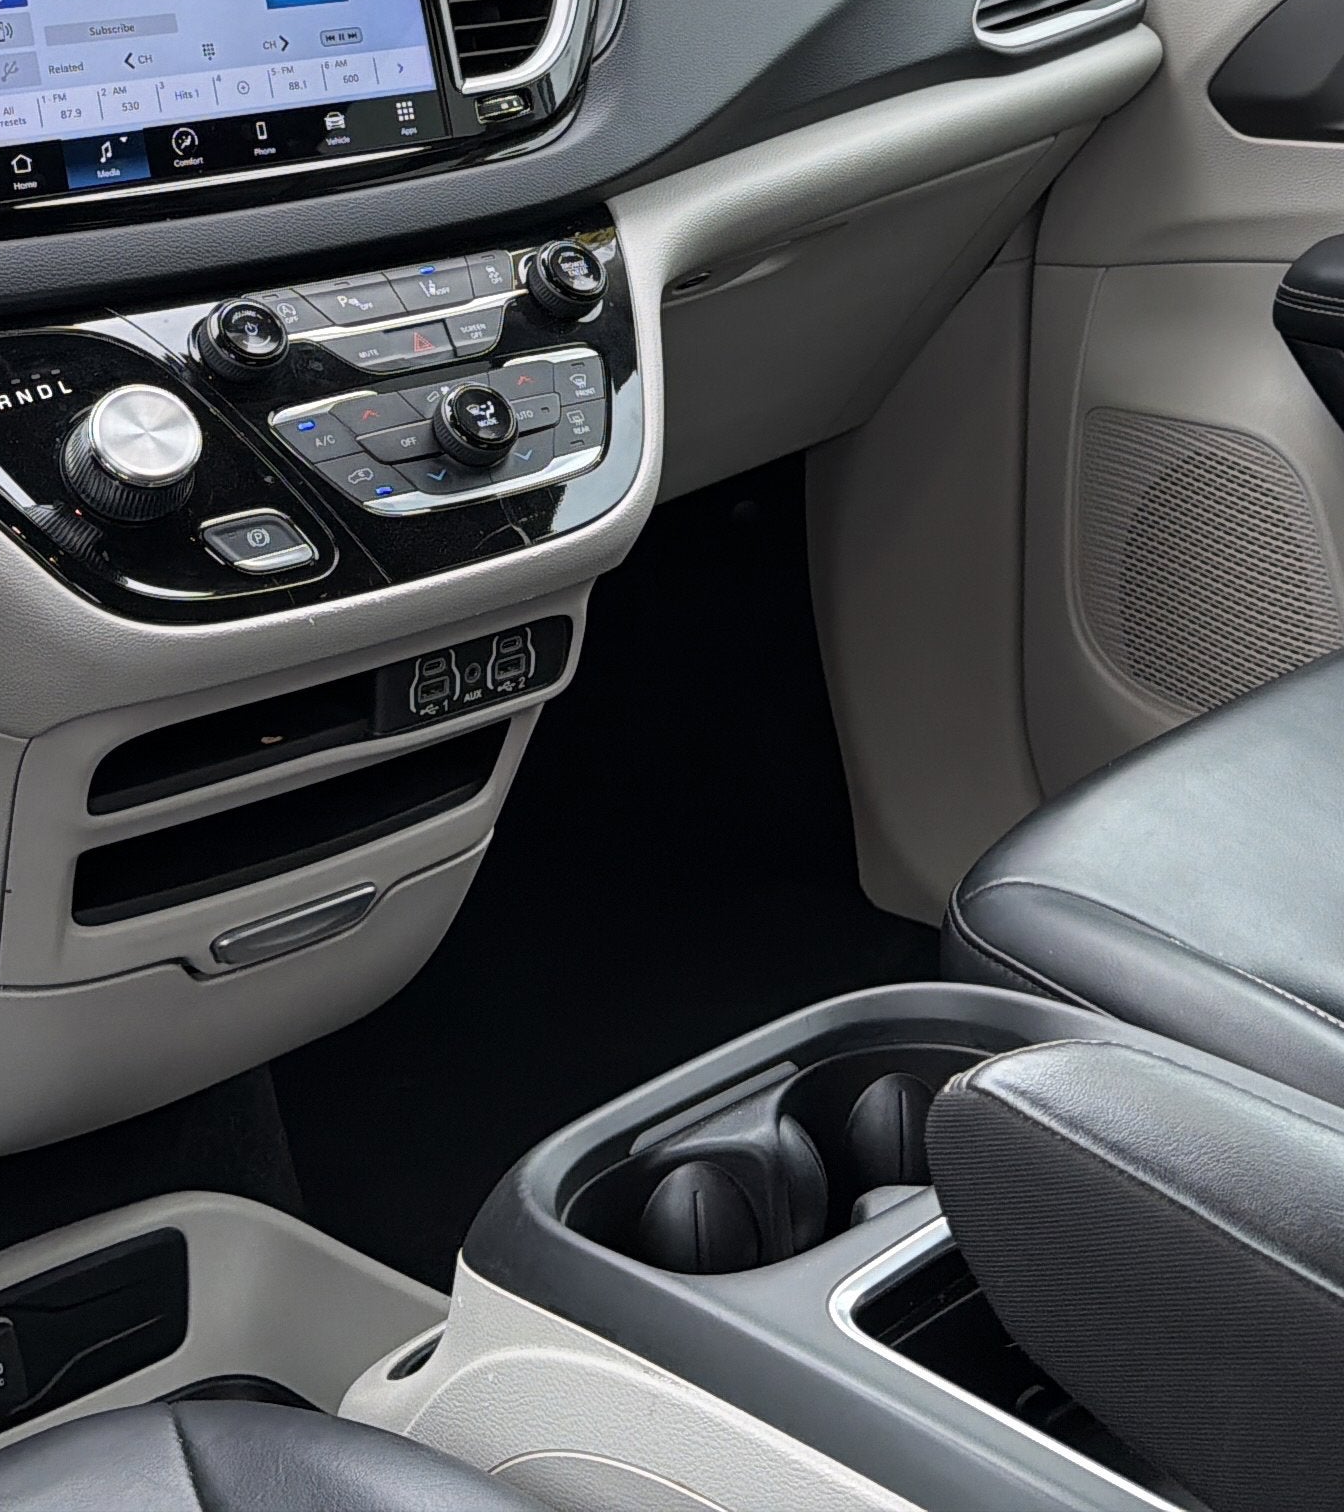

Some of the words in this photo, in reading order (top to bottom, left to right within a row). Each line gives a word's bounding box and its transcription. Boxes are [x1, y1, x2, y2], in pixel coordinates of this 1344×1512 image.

[89, 23, 135, 36] Subscribe
[262, 39, 277, 50] CH
[137, 54, 153, 65] CH
[48, 62, 84, 75] Related
[343, 74, 359, 84] 600
[288, 80, 307, 91] 88.1
[174, 90, 193, 101] Hits
[3, 106, 15, 116] All
[121, 101, 140, 112] 530
[60, 108, 82, 120] 87.9
[401, 126, 418, 137] Apps
[326, 136, 351, 147] Vehicle
[254, 146, 277, 157] Phone
[174, 156, 204, 168] Comfort
[97, 168, 121, 178] Media
[13, 180, 38, 191] Home
[459, 323, 487, 334] SCREEN
[470, 331, 483, 340] OFF
[358, 348, 379, 359] MUTE
[516, 410, 534, 421] UTO
[477, 417, 499, 428] MODE
[573, 424, 591, 435] REAR
[314, 434, 336, 448] A/C
[400, 436, 417, 448] OFF
[518, 676, 526, 689] 2
[463, 689, 483, 703] AUX
[442, 699, 449, 712] 1
